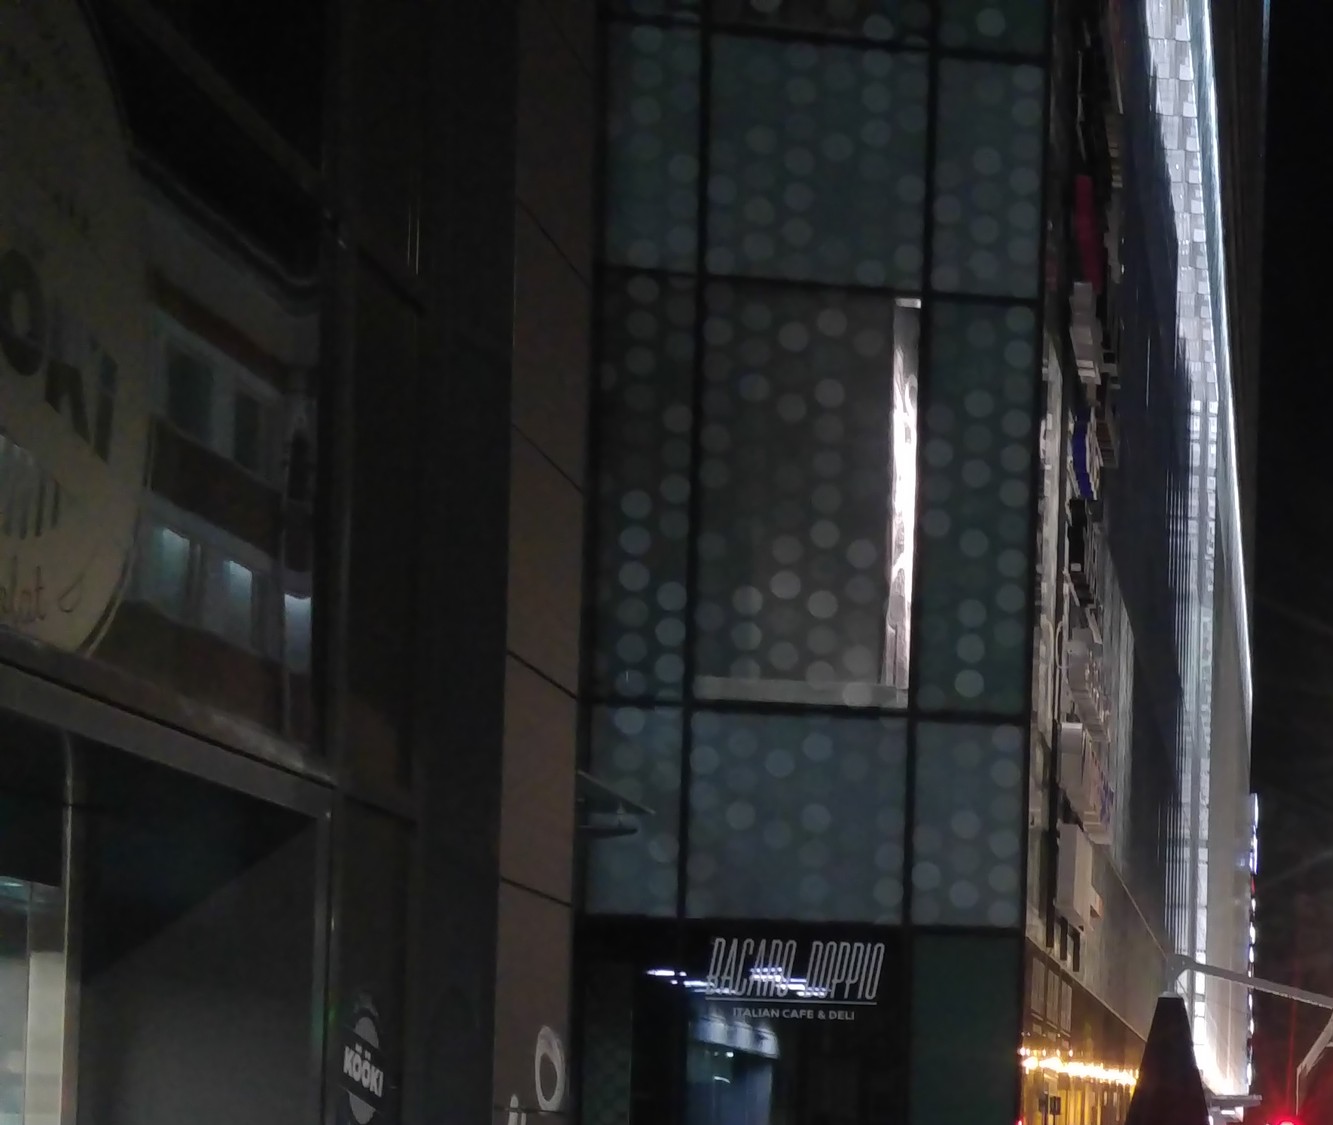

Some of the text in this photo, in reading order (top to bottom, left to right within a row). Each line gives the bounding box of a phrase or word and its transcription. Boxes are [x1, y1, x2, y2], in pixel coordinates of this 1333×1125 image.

[705, 937, 886, 1000] BACARO DOPPIO
[733, 1006, 855, 1021] ITALIAN CAFE & DELI
[343, 1042, 384, 1098] KÖÖKI
